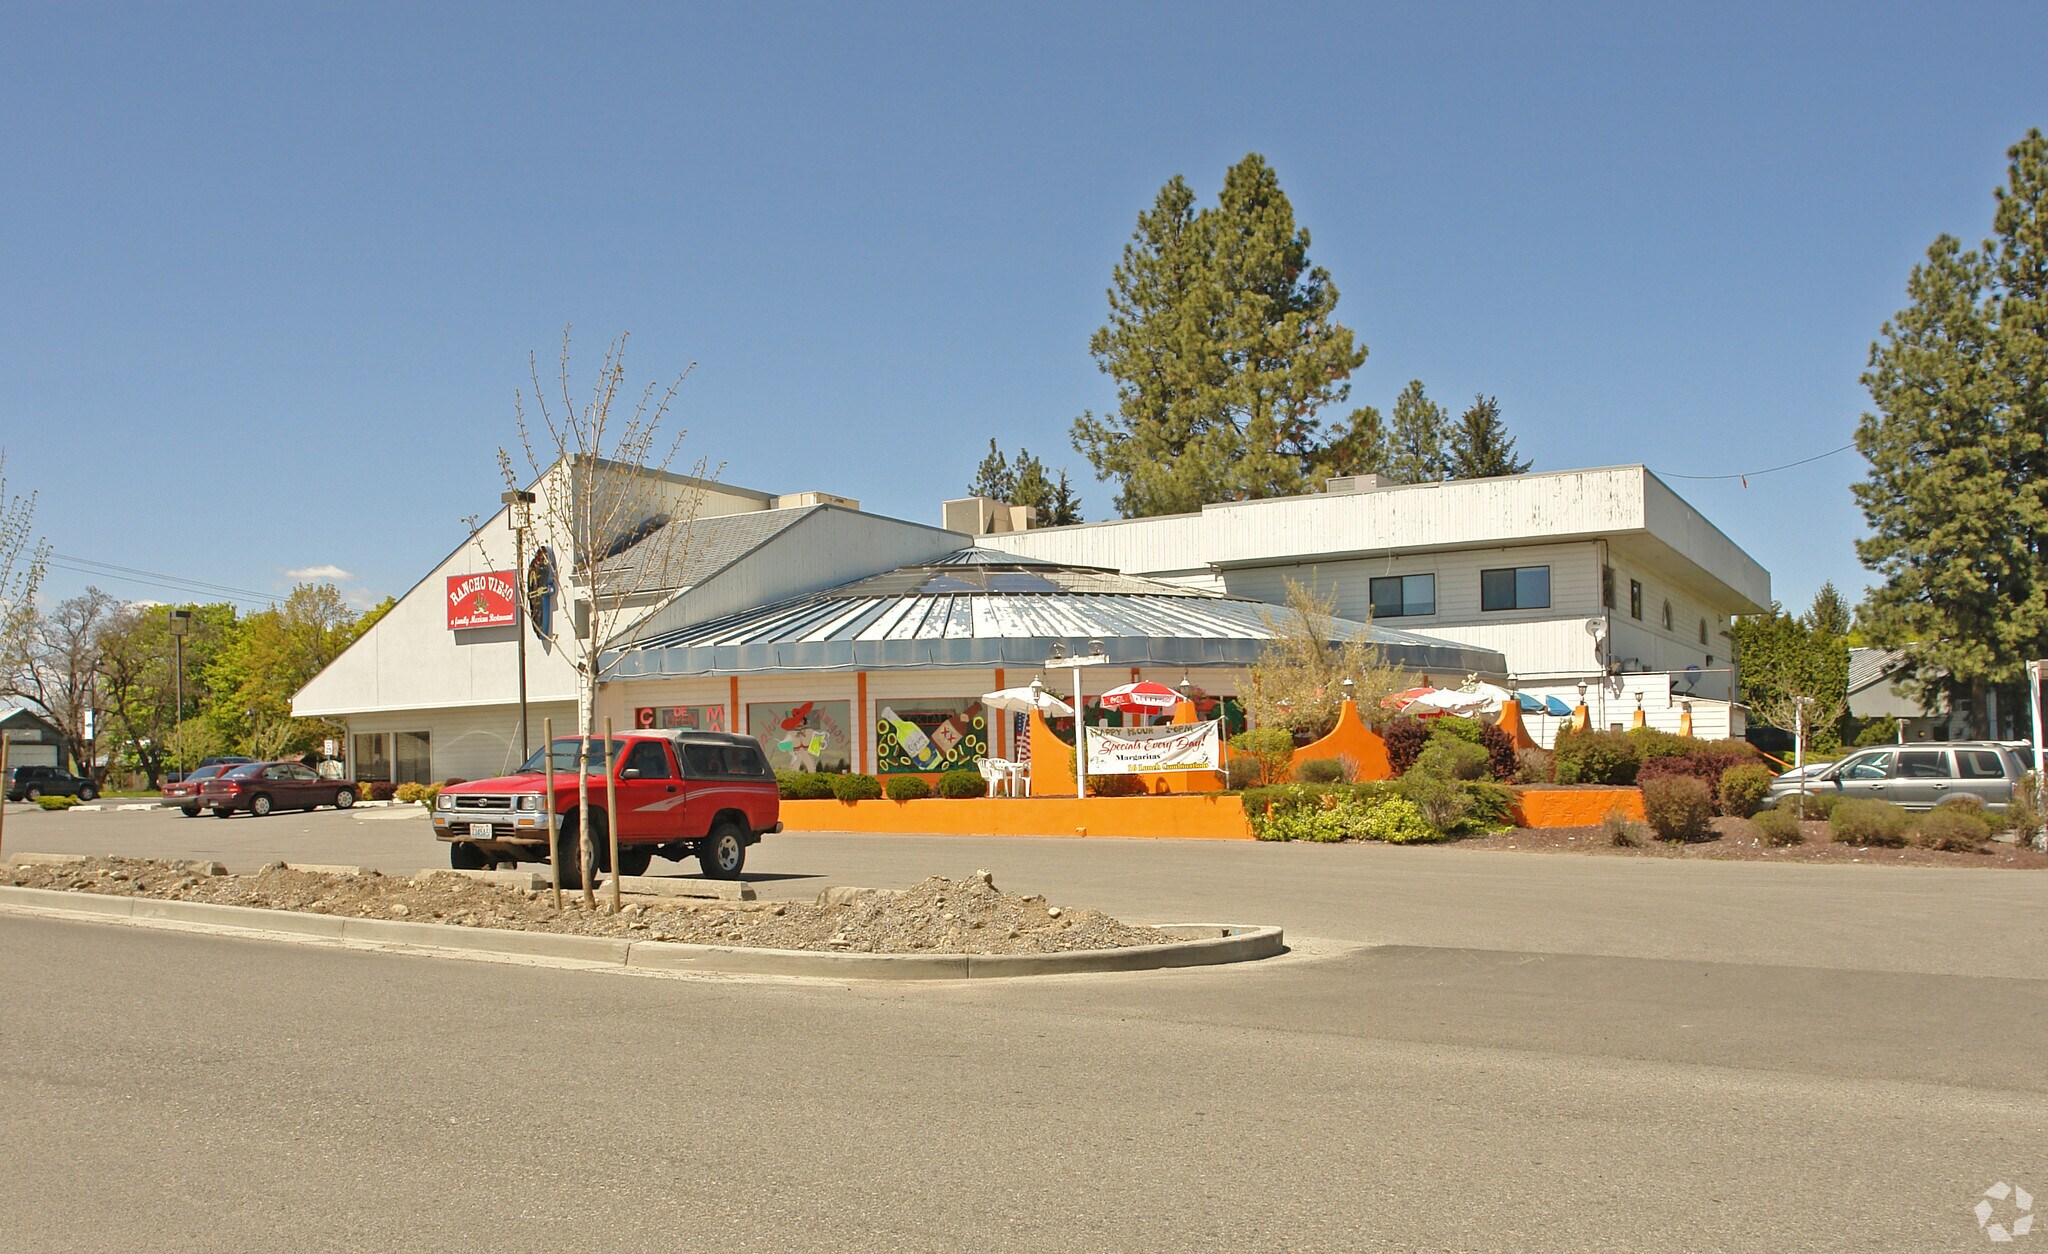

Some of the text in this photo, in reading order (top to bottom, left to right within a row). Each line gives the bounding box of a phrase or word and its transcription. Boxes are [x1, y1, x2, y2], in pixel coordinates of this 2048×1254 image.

[449, 576, 514, 606] RANCHO VIEJO
[673, 706, 688, 717] DE
[1090, 724, 1193, 738] HAPPY HOUR 2-6PM
[1098, 733, 1207, 755] Specials Every Day!
[1116, 753, 1161, 761] Margaritas
[1138, 762, 1161, 771] Lunch
[1162, 761, 1209, 770] Combinations
